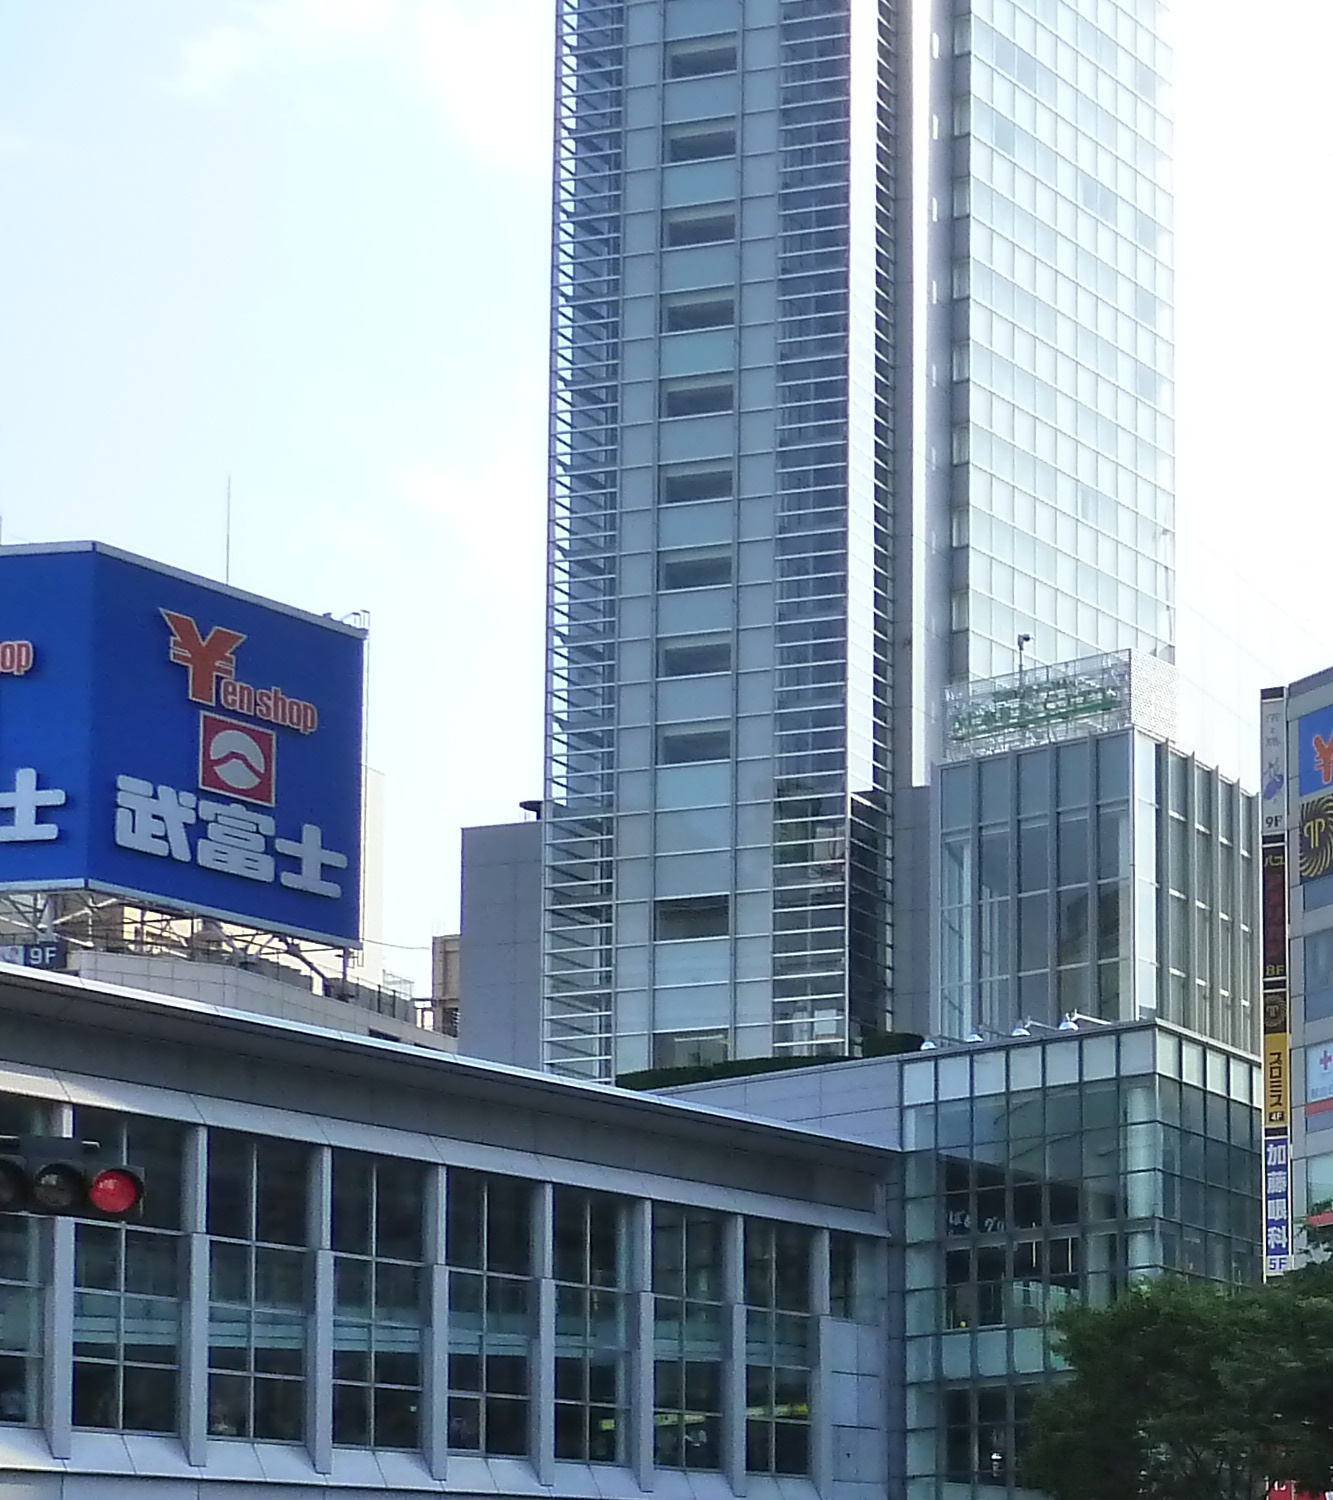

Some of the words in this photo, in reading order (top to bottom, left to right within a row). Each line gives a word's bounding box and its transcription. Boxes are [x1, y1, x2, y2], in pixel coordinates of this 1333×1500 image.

[1265, 816, 1282, 828] 9F
[114, 773, 348, 899] 武富士
[30, 947, 57, 965] 9F
[1269, 1052, 1282, 1107] プロミス
[1270, 1112, 1283, 1121] 4F
[1267, 1144, 1288, 1248] 加藤眼科
[1269, 1258, 1287, 1271] 5F
